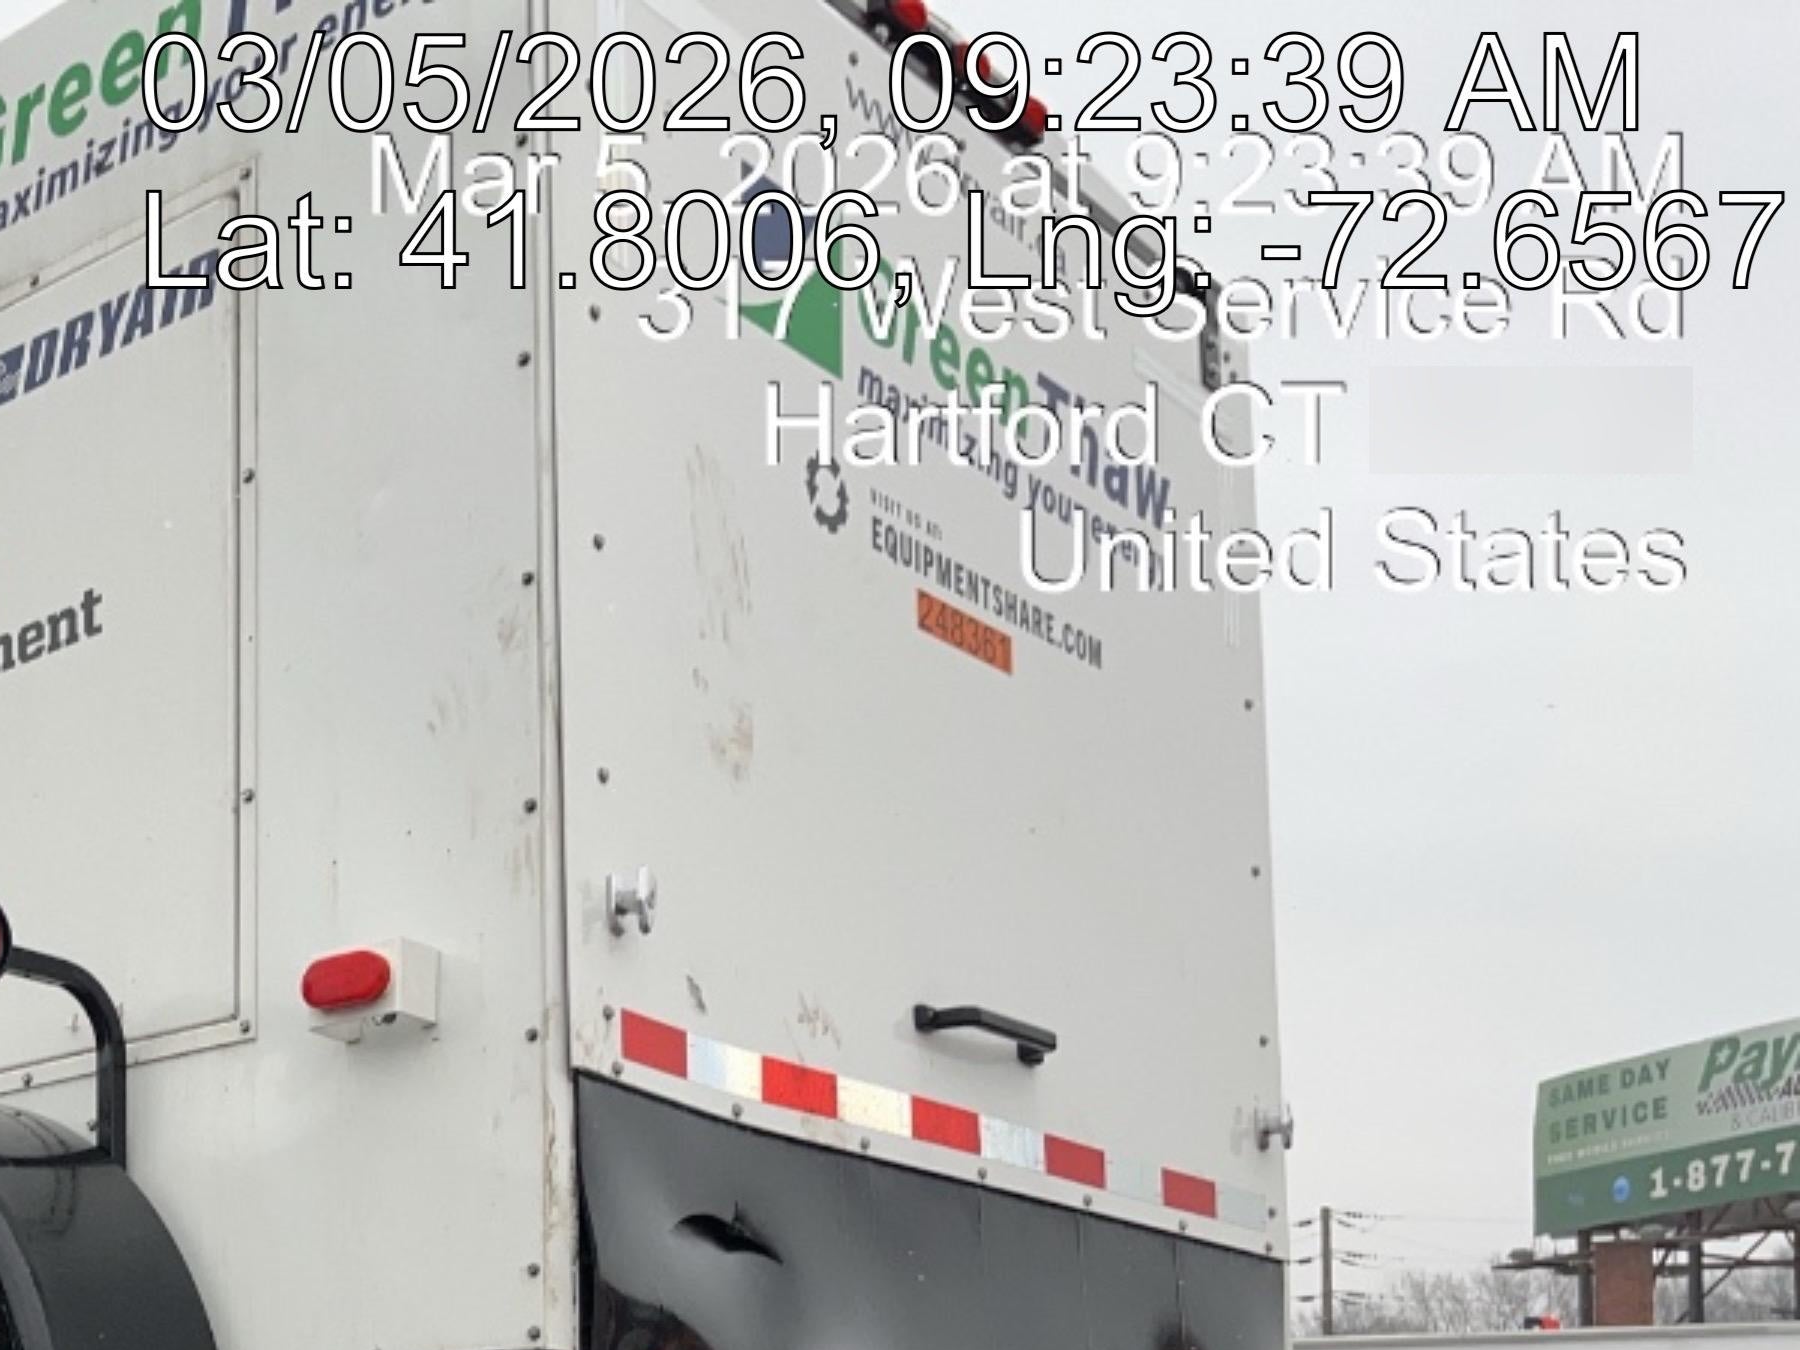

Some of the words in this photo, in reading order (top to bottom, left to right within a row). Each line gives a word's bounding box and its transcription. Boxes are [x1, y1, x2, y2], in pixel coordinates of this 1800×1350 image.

[23, 247, 220, 394] DRYAIR
[871, 514, 1103, 670] EQUIPMENTSHARE.COM
[1550, 1075, 1611, 1108] SAME
[1619, 1057, 1671, 1089] DAY
[1698, 1028, 1800, 1094] Pay
[1550, 1096, 1669, 1144] SERVICE
